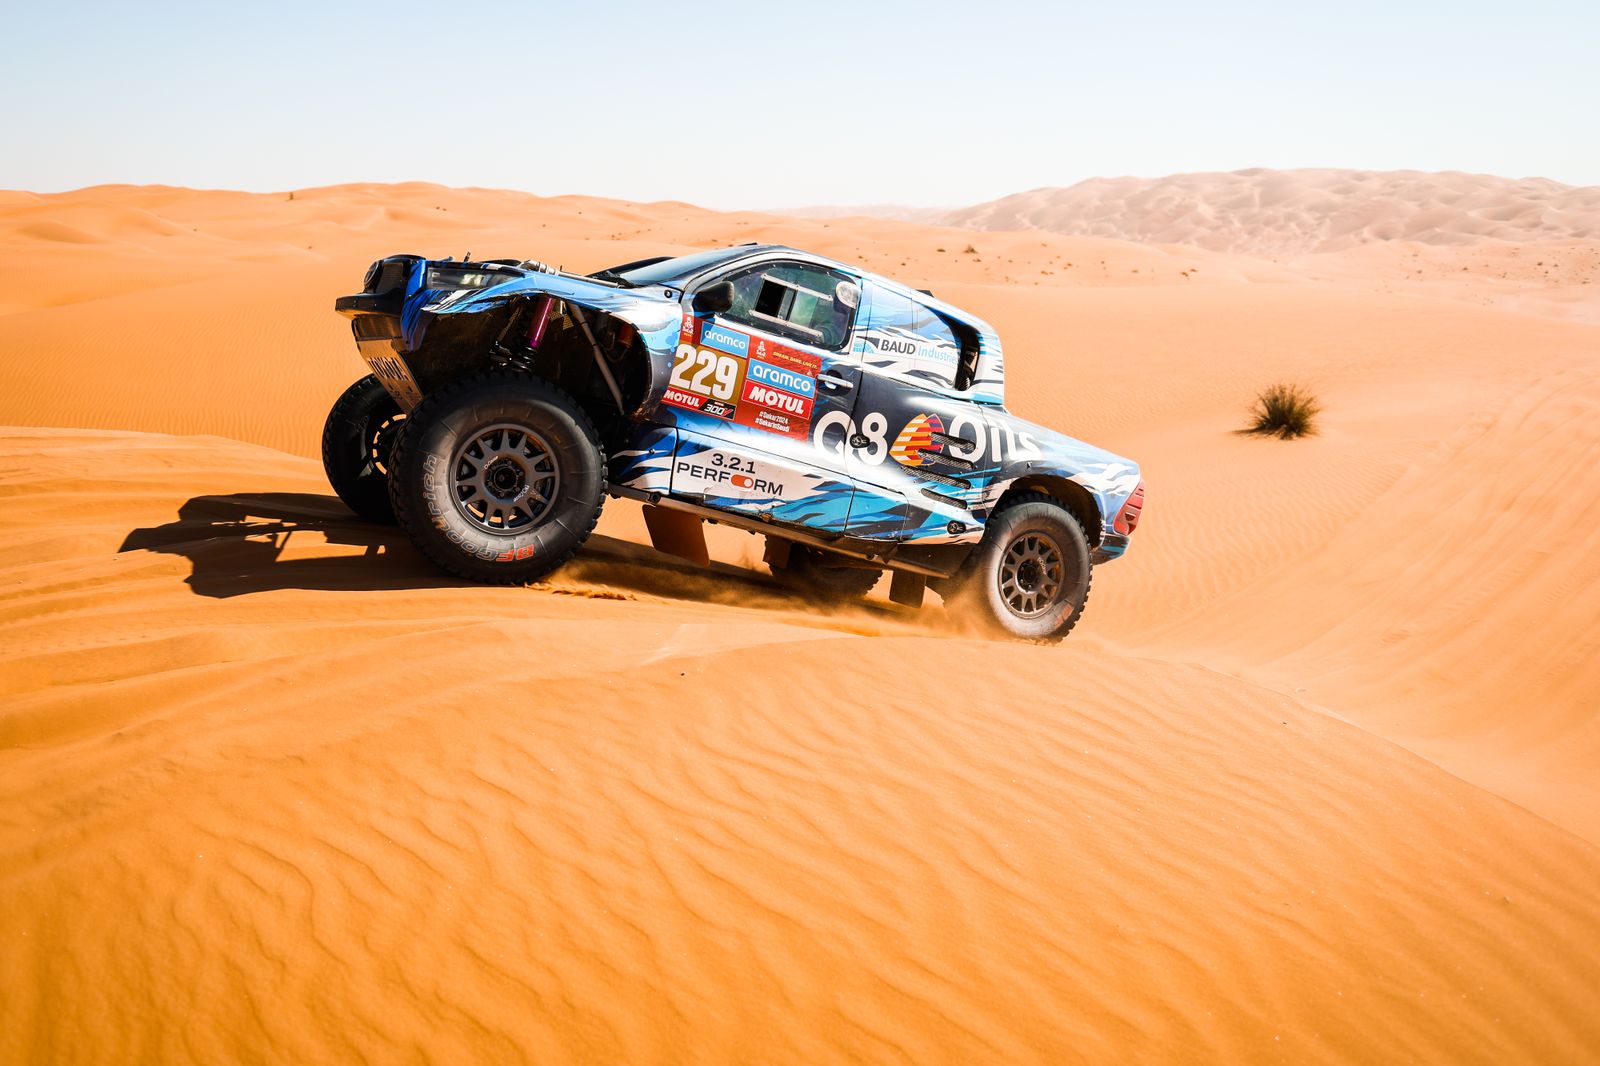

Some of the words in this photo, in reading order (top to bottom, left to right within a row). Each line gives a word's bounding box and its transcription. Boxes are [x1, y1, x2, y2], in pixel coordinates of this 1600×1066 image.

[704, 330, 746, 350] aramco
[880, 340, 916, 355] BAUD
[669, 343, 739, 400] 229
[753, 365, 811, 392] aramco
[663, 390, 701, 407] MOTUL
[749, 386, 805, 415] MOTUL
[813, 410, 888, 466] Q8
[948, 413, 1042, 464] Oils
[711, 453, 756, 474] 3.2.1
[677, 462, 784, 496] PERFORM
